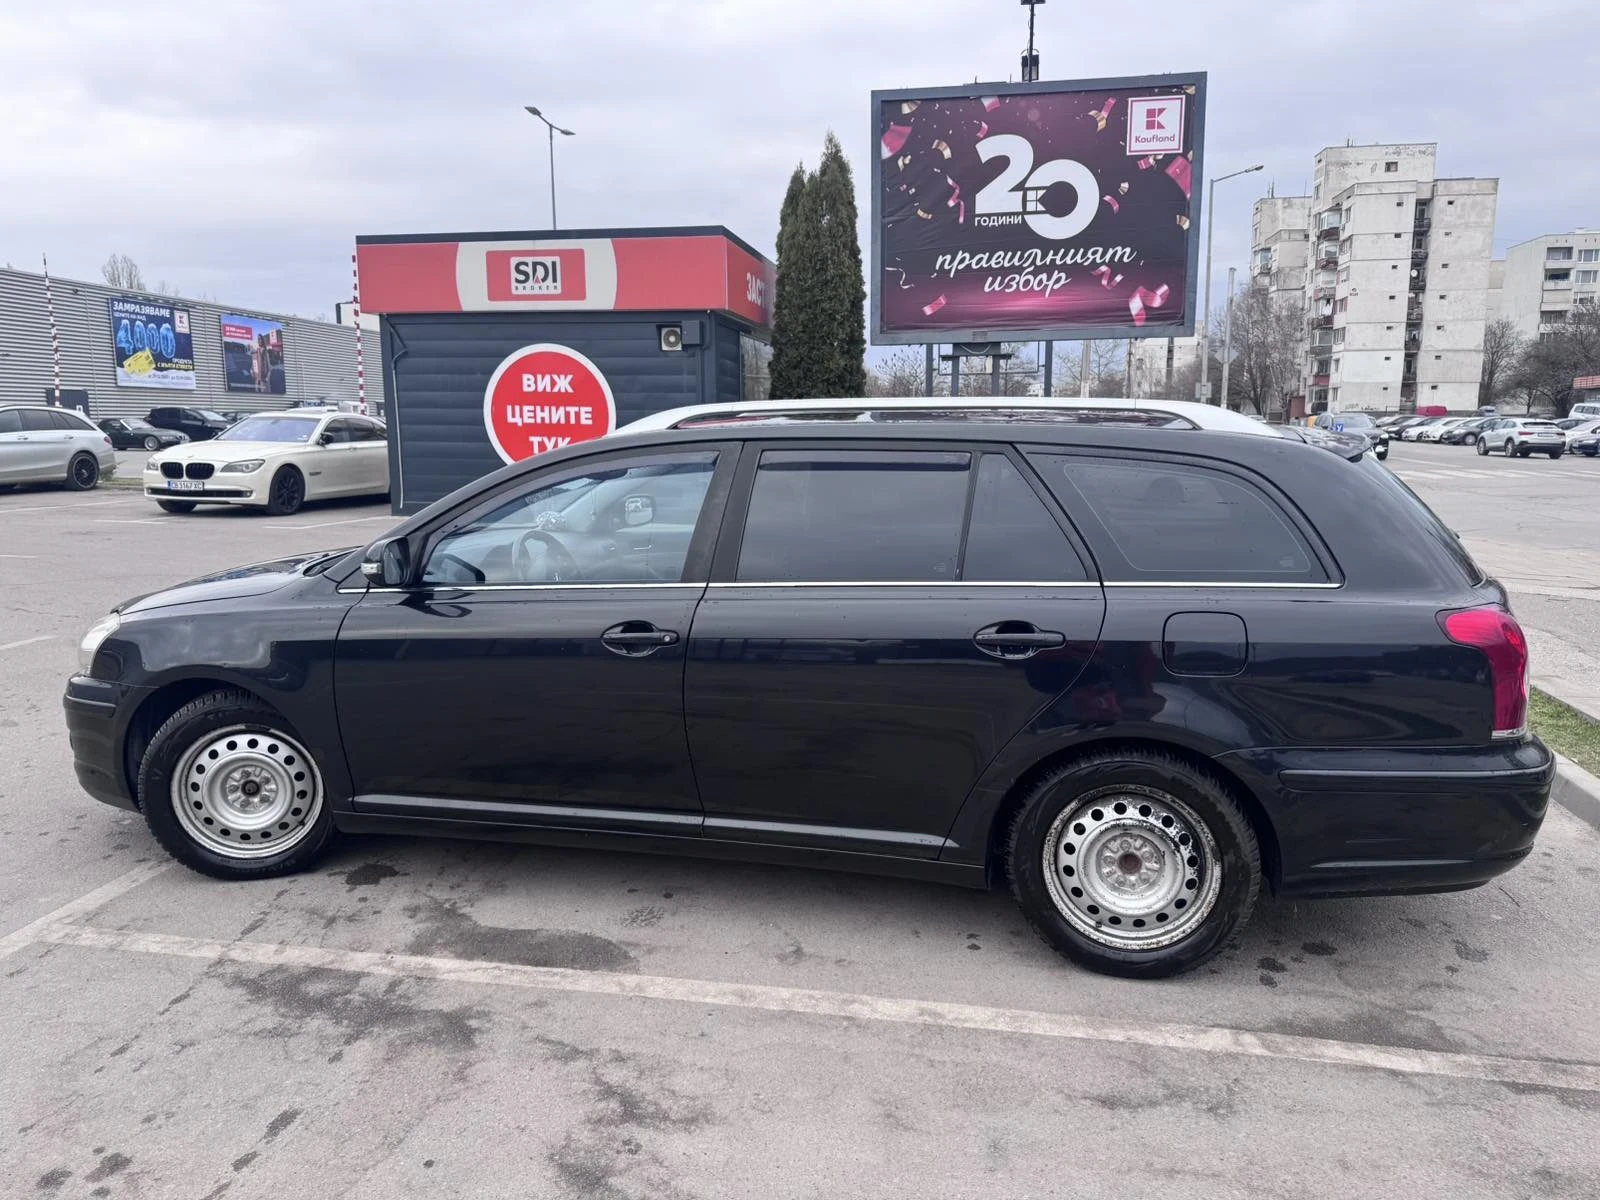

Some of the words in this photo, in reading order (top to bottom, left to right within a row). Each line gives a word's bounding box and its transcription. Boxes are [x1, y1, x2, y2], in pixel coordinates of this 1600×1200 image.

[1135, 134, 1175, 144] Kaufland
[975, 134, 1100, 240] 20
[975, 215, 1022, 228] ГОДИНИ
[514, 261, 558, 284] SDI
[935, 245, 1137, 278] правилният
[984, 266, 1072, 299] избор
[113, 301, 170, 317] ЗАМРАЗЯВАМЕ
[117, 319, 176, 358] 4000
[522, 373, 574, 393] ВИЖ
[506, 405, 593, 427] ЦЕНИТЕ
[528, 436, 572, 455] ТУК
